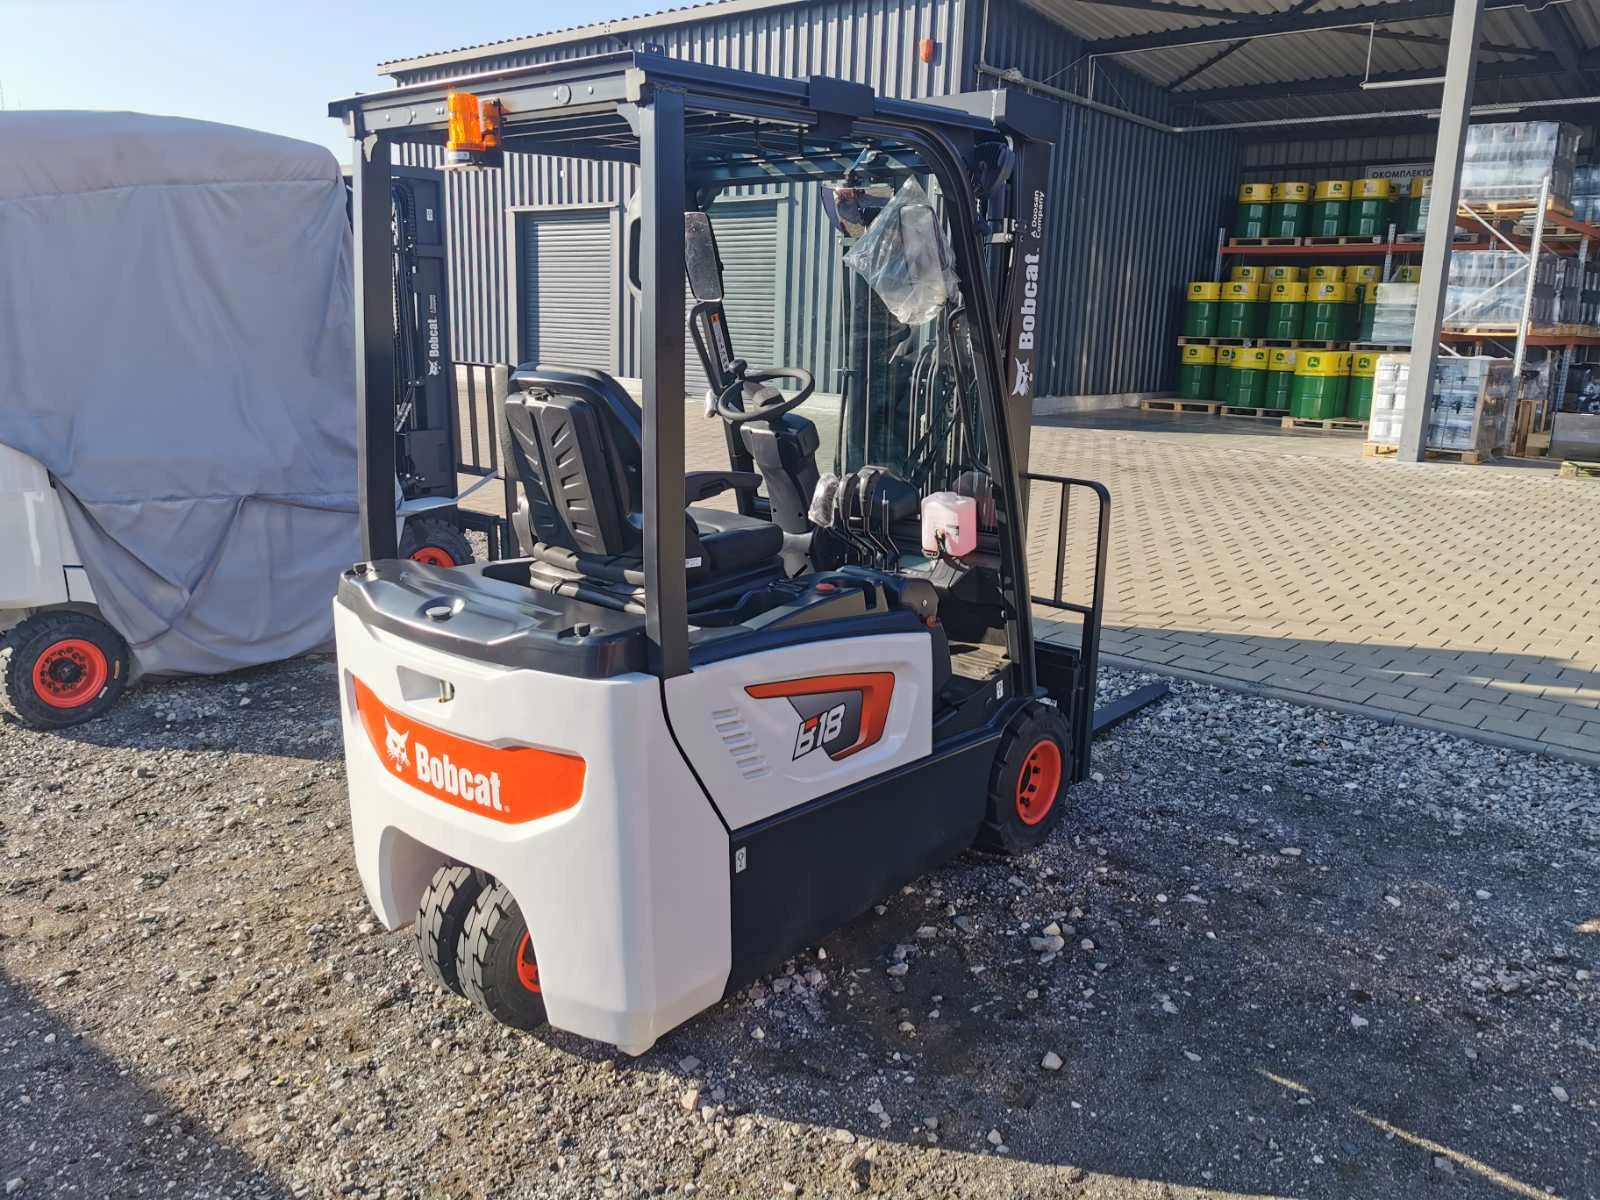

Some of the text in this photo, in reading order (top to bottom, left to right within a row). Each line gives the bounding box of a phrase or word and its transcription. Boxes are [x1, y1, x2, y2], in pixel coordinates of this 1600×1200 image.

[1031, 190, 1040, 238] A Doosan
[1035, 191, 1045, 239] Company
[1018, 253, 1040, 350] Bobcat
[427, 319, 440, 357] Bobcat
[792, 703, 847, 761] B18
[414, 741, 503, 812] Bobcat
